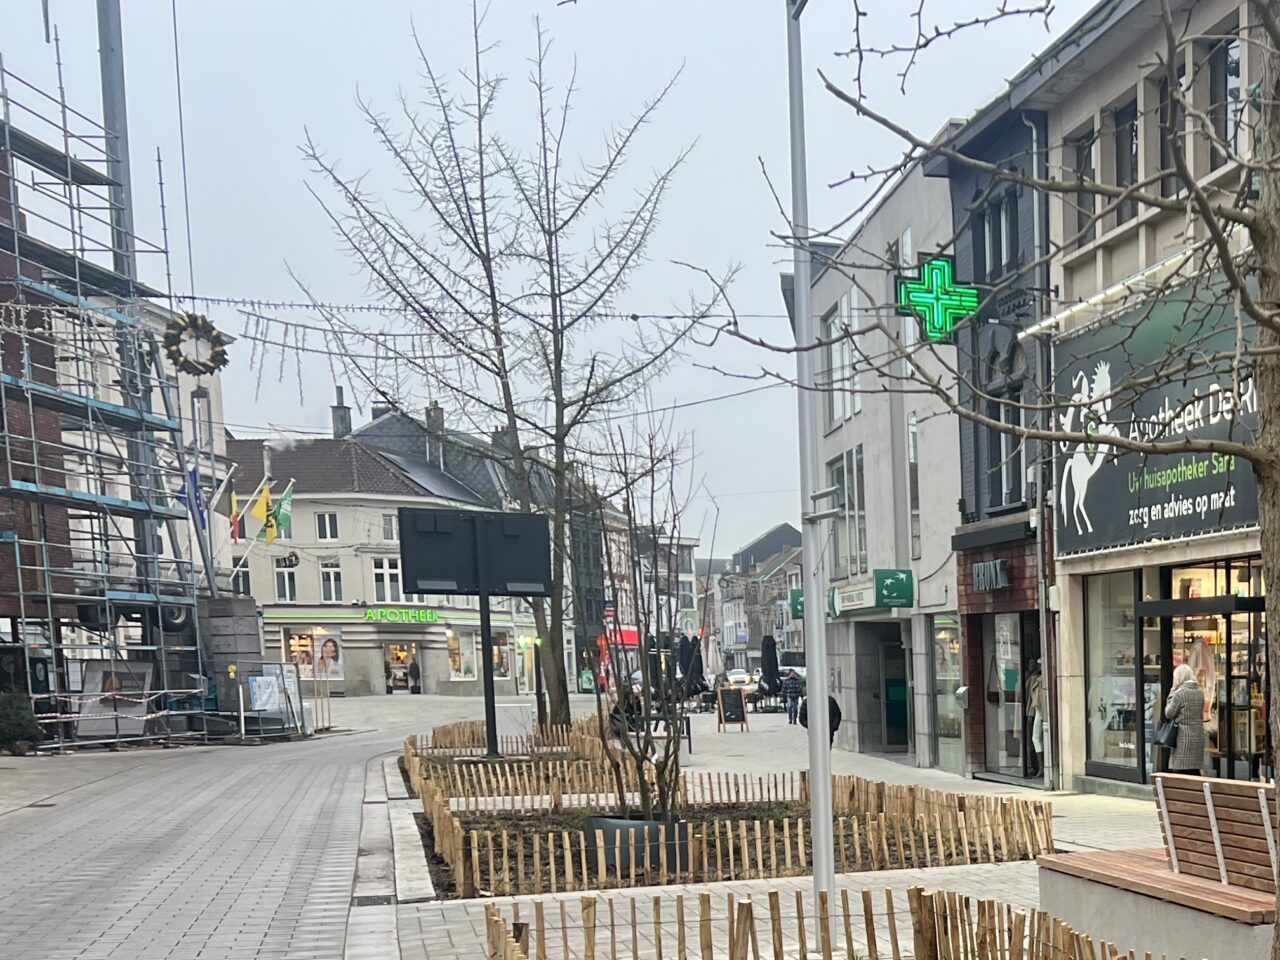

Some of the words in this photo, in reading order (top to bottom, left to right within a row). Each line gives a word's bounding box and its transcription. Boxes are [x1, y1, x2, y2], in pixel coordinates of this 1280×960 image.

[1128, 387, 1205, 456] Apotheek
[1209, 383, 1234, 425] De
[1128, 469, 1144, 493] Uw
[1144, 455, 1209, 492] huisapotheker
[1211, 451, 1236, 475] Sara
[1128, 506, 1149, 528] zorg
[1150, 503, 1162, 521] en
[1163, 493, 1193, 519] advies
[1195, 495, 1208, 519] op
[1210, 486, 1236, 510] maat
